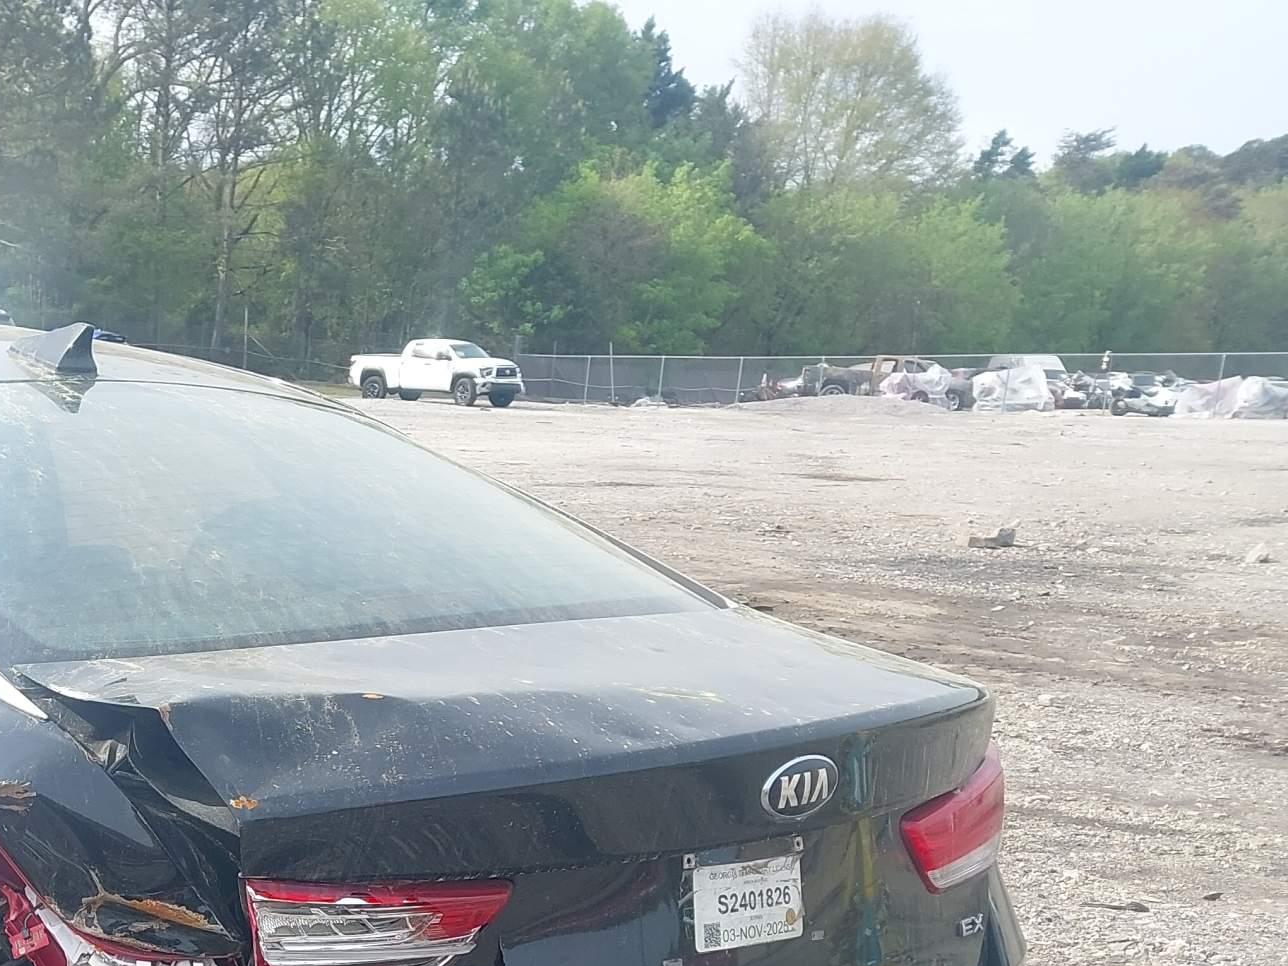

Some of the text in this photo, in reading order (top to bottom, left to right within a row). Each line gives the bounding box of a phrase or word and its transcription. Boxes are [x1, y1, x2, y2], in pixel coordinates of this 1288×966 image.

[778, 767, 829, 809] KIA
[718, 885, 791, 915] S2401826
[722, 920, 789, 943] 03-NOV-2025
[961, 913, 984, 937] EX
